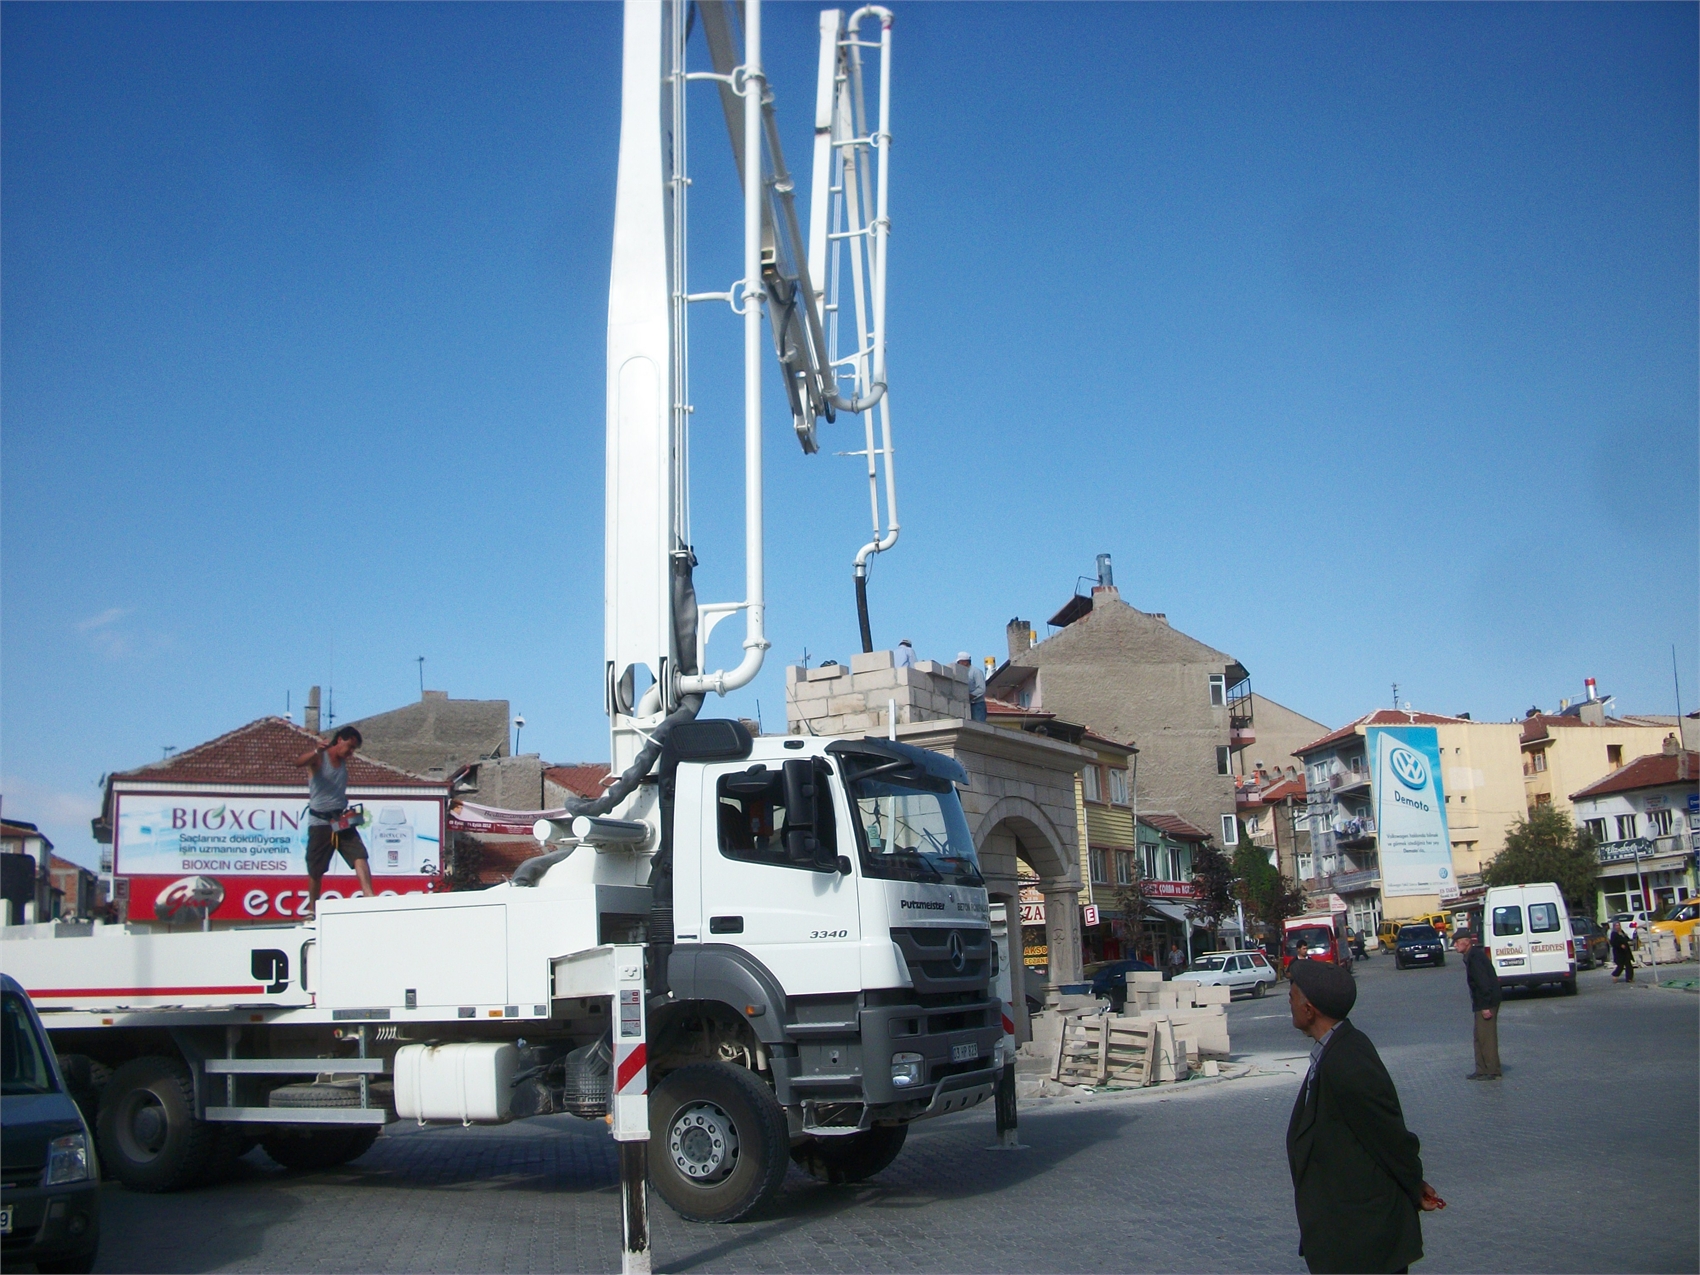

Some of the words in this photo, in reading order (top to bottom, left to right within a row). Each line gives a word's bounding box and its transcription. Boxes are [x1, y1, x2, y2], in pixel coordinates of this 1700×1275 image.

[1394, 790, 1430, 812] Demoto
[172, 804, 299, 831] BIOXCIN
[179, 833, 227, 847] Saçlarınız
[229, 833, 291, 847] dökülüyorsa
[179, 845, 197, 856] işin
[199, 846, 248, 855] uzmanına
[249, 846, 291, 857] güvenin.
[182, 860, 231, 871] BIOXCIN
[234, 860, 288, 871] GENESIS
[117, 883, 126, 895] E
[901, 899, 945, 911] Putzmeister
[1087, 908, 1095, 922] E
[810, 929, 848, 939] 3340
[0, 1211, 9, 1228] 9
